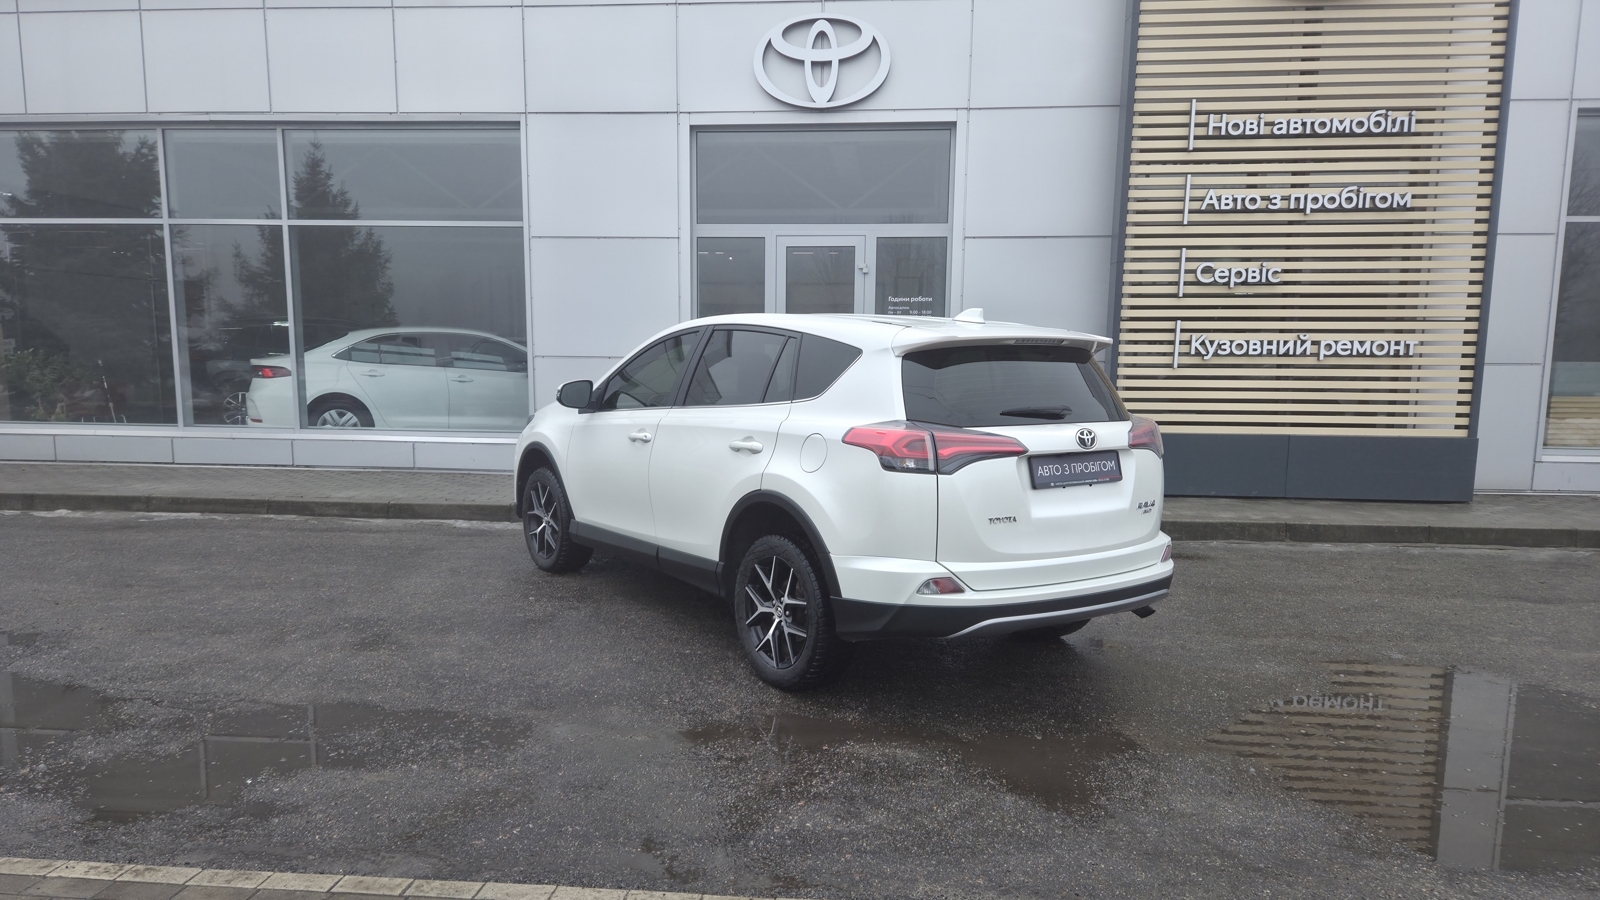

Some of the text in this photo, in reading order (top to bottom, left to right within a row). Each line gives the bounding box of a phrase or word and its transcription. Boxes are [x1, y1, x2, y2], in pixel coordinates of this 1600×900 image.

[1207, 109, 1417, 136] Нові автомобілі
[1200, 186, 1412, 215] Авто з пробігом
[1195, 262, 1282, 289] Сервіс
[1189, 334, 1419, 361] Кузовний ремонт
[1037, 460, 1116, 477] АВТО З ПРОБІГОМ
[988, 515, 1017, 525] TOYOTA
